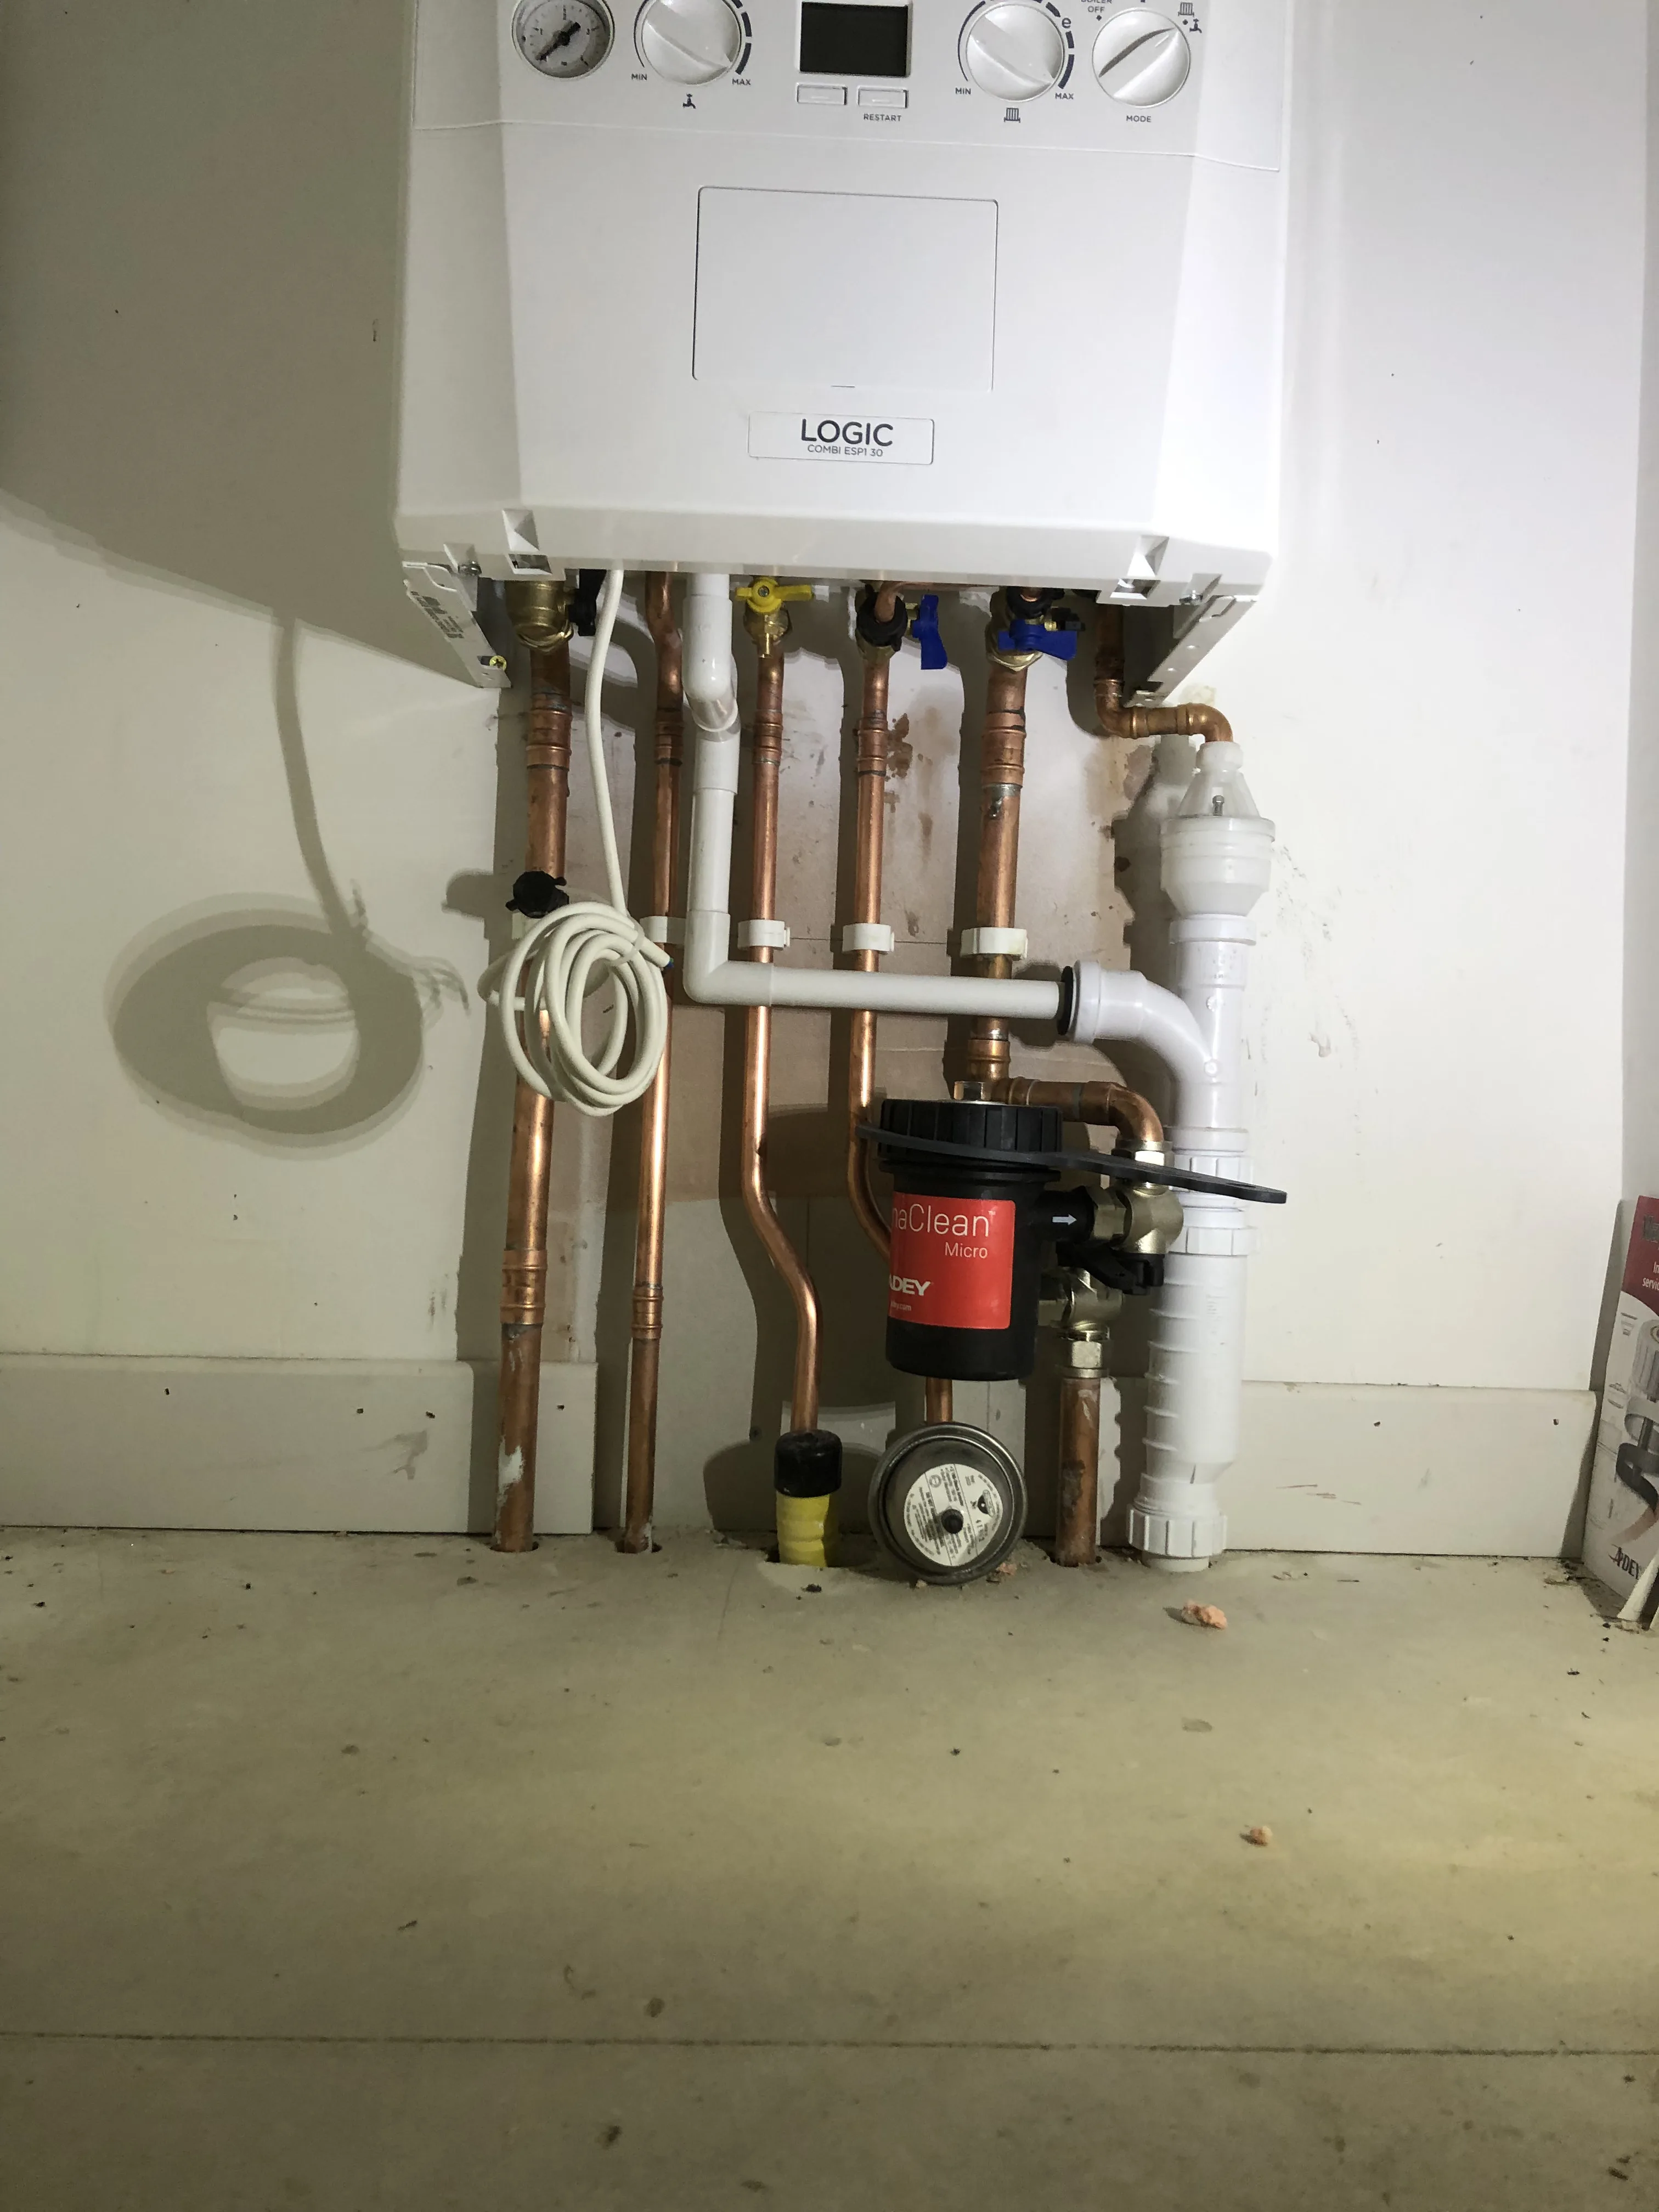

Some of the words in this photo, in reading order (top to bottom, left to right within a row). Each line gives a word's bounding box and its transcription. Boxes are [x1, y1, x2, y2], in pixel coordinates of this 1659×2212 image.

[864, 113, 902, 122] RESTART
[801, 419, 893, 447] LOGIC
[807, 444, 841, 455] COMBI
[870, 448, 883, 457] 30
[945, 1242, 988, 1259] Micro
